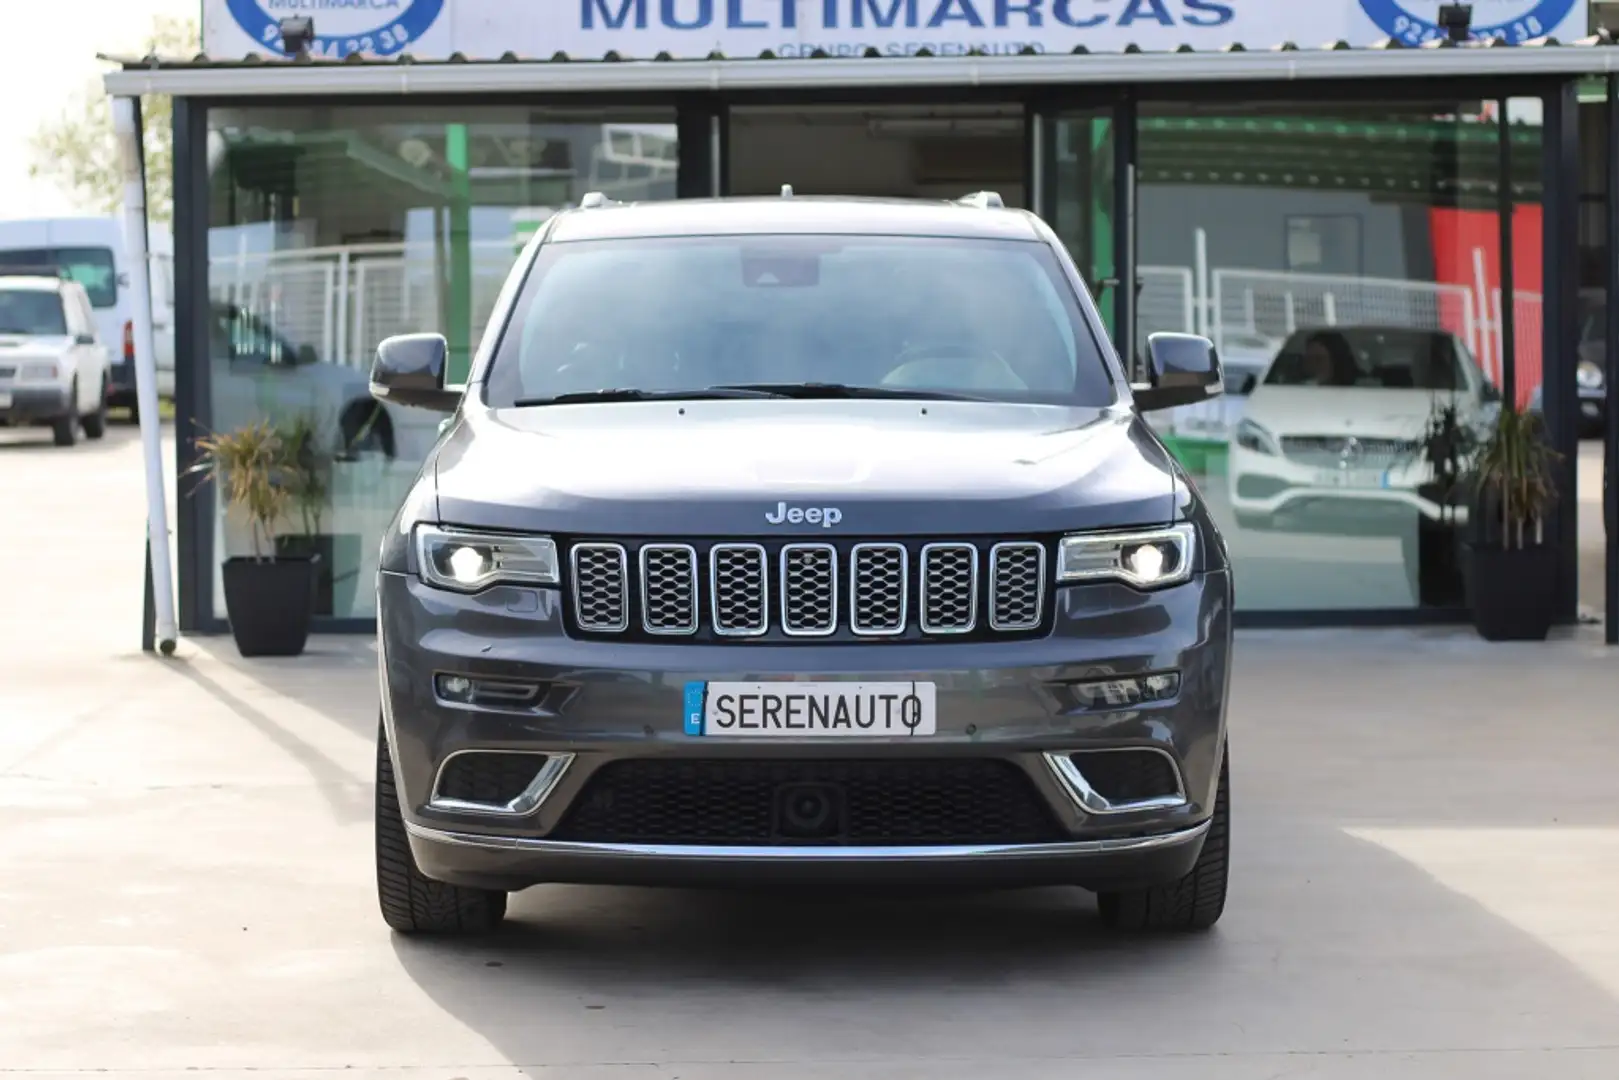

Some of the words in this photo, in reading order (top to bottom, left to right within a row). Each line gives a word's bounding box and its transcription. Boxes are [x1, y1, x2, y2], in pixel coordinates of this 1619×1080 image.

[580, 0, 1235, 30] MULTIMARCAS
[765, 502, 842, 528] Jeep
[716, 694, 922, 729] SERENAUTO
